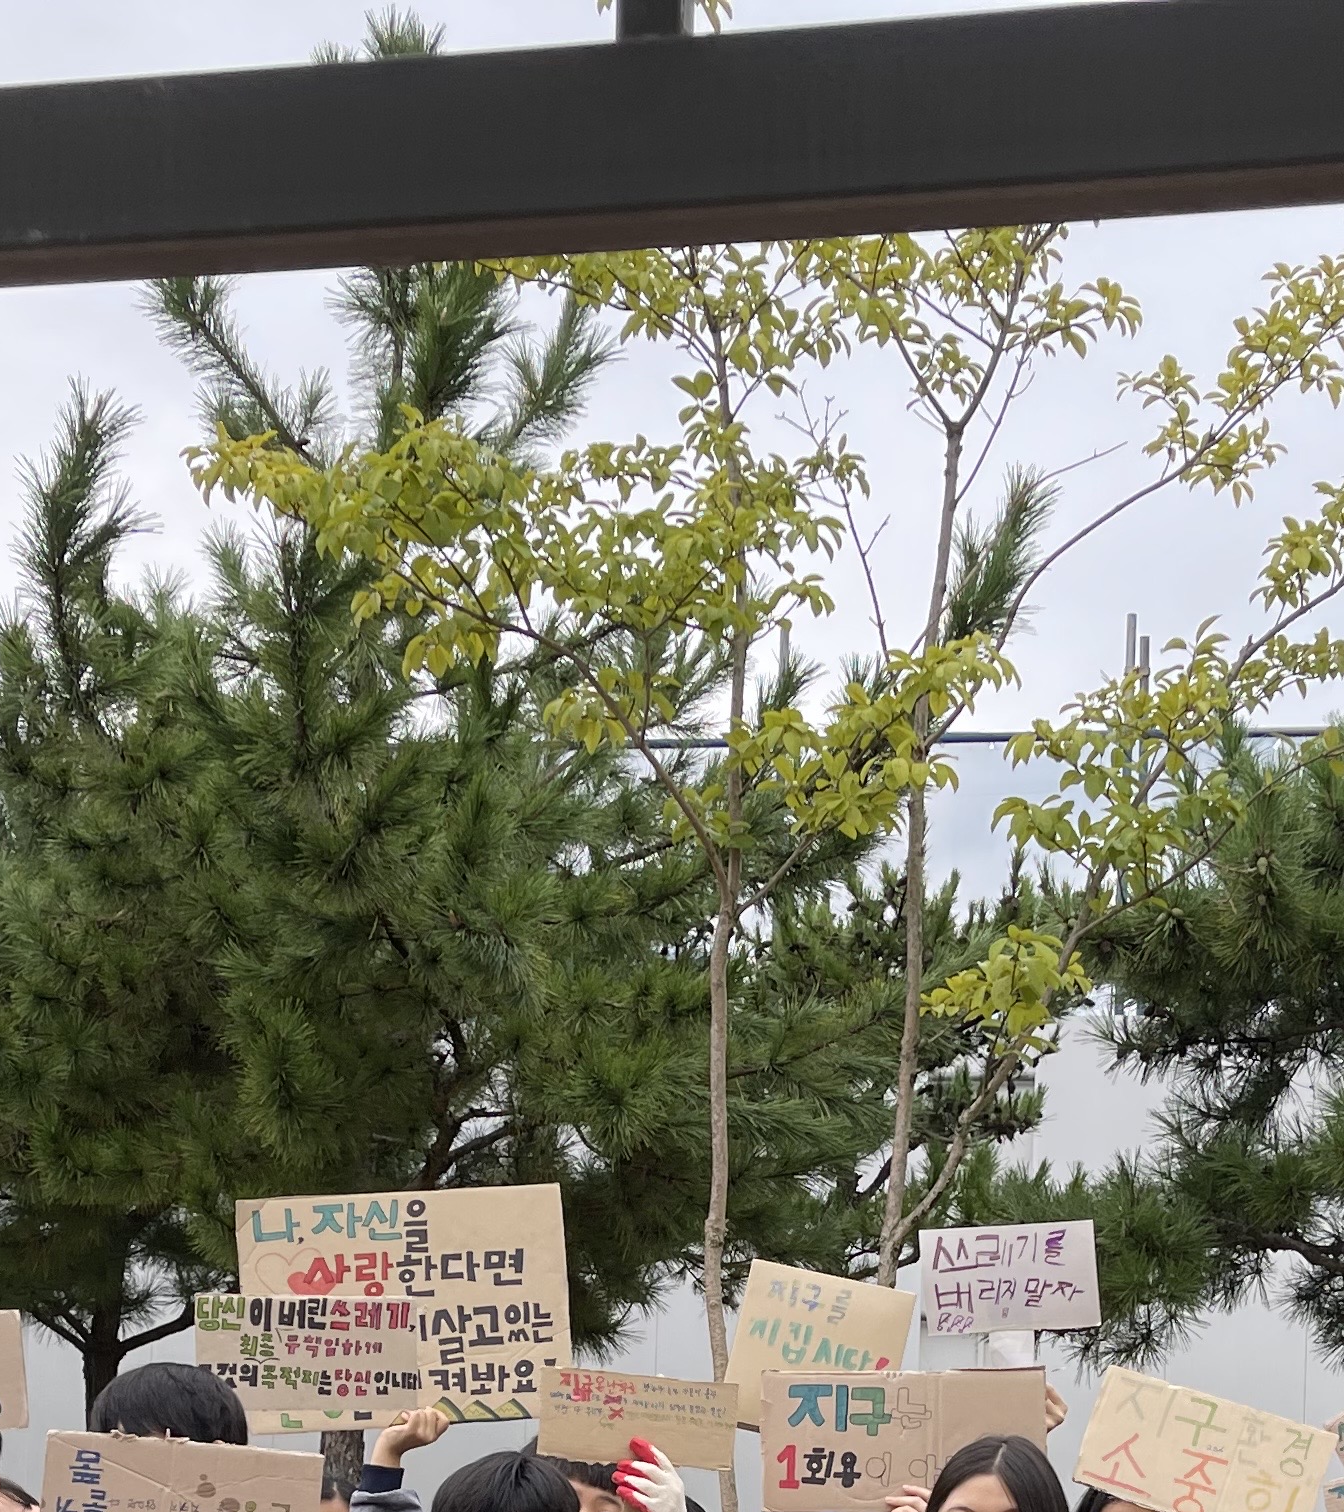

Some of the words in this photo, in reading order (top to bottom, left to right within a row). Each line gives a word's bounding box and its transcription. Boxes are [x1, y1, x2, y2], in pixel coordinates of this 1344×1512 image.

[252, 1208, 304, 1244] 나,
[311, 1199, 429, 1253] 자신을
[303, 1248, 524, 1297] 사랑한다면
[932, 1229, 1067, 1272] 쓰레기를
[769, 1278, 853, 1325] 지구를
[240, 1333, 275, 1357] 최종
[285, 1334, 383, 1359] 무책임하게
[199, 1363, 258, 1388] 것의
[788, 1384, 932, 1436] 지구는
[777, 1445, 892, 1489] 1회용이
